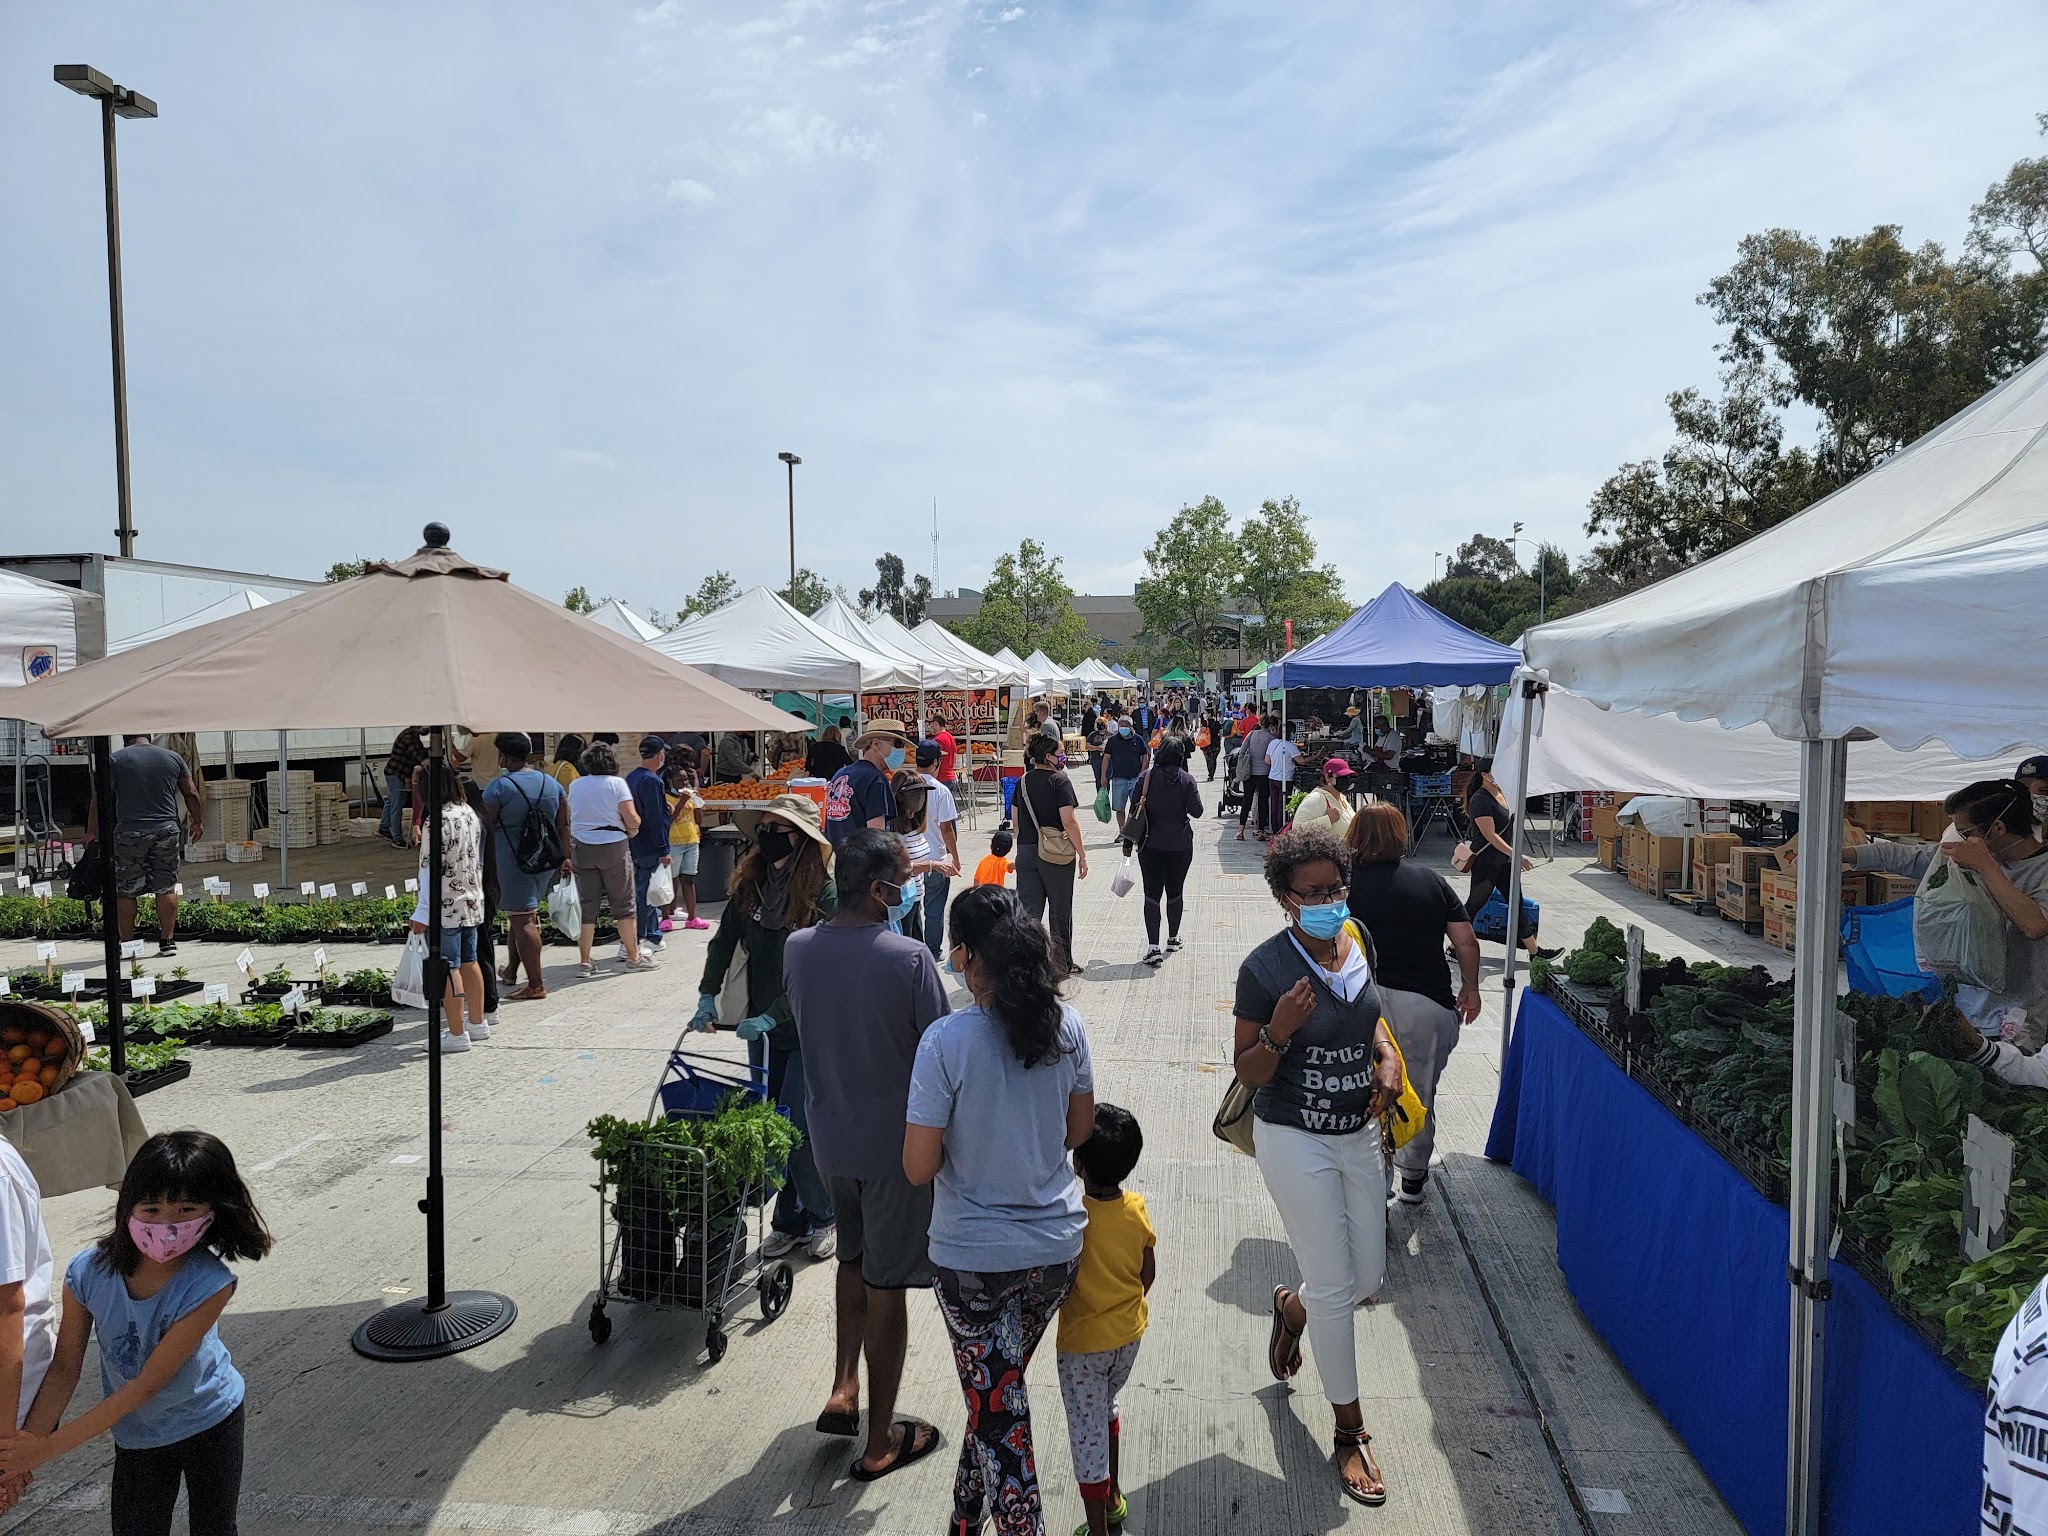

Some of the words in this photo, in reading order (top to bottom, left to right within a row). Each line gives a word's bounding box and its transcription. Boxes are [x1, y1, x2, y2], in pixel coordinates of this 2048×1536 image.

[898, 692, 933, 704] Certifed
[934, 690, 966, 702] Organic
[868, 704, 914, 723] Ken's
[947, 700, 997, 720] Notch
[1305, 1043, 1365, 1065] True
[1301, 1063, 1374, 1093] Beaut
[1303, 1092, 1332, 1110] Is
